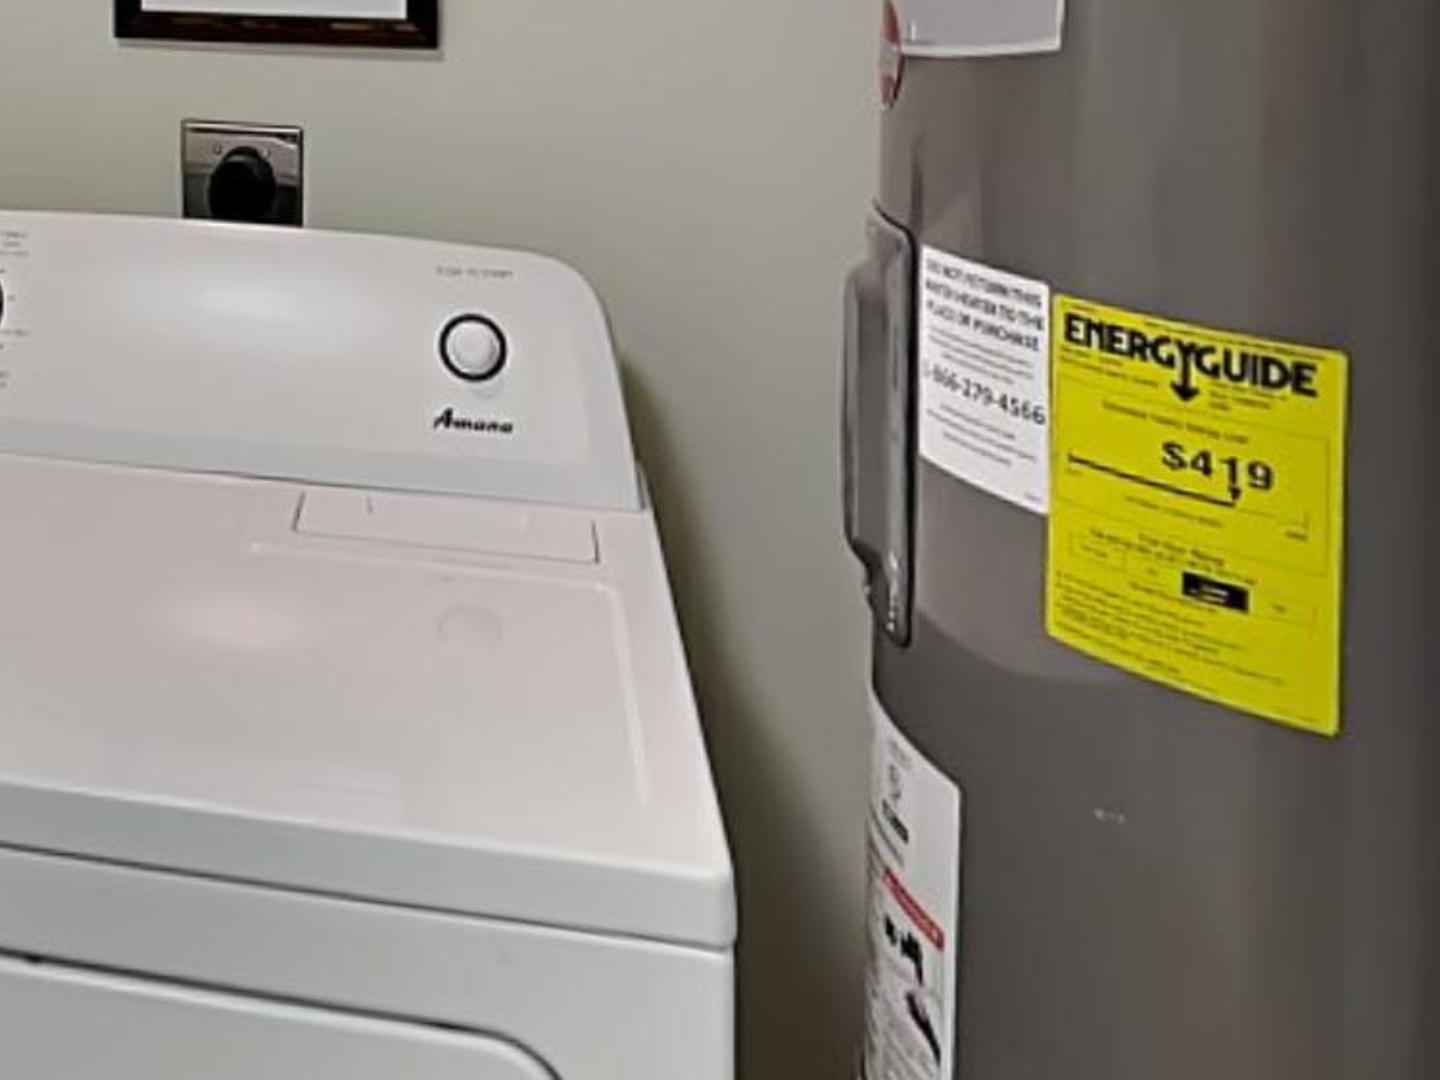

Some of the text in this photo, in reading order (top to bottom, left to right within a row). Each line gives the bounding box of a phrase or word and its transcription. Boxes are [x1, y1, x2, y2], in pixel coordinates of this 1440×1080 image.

[1064, 312, 1319, 398] ENERGYGUIDE
[433, 407, 514, 434] Amana
[1161, 441, 1276, 493] $419
